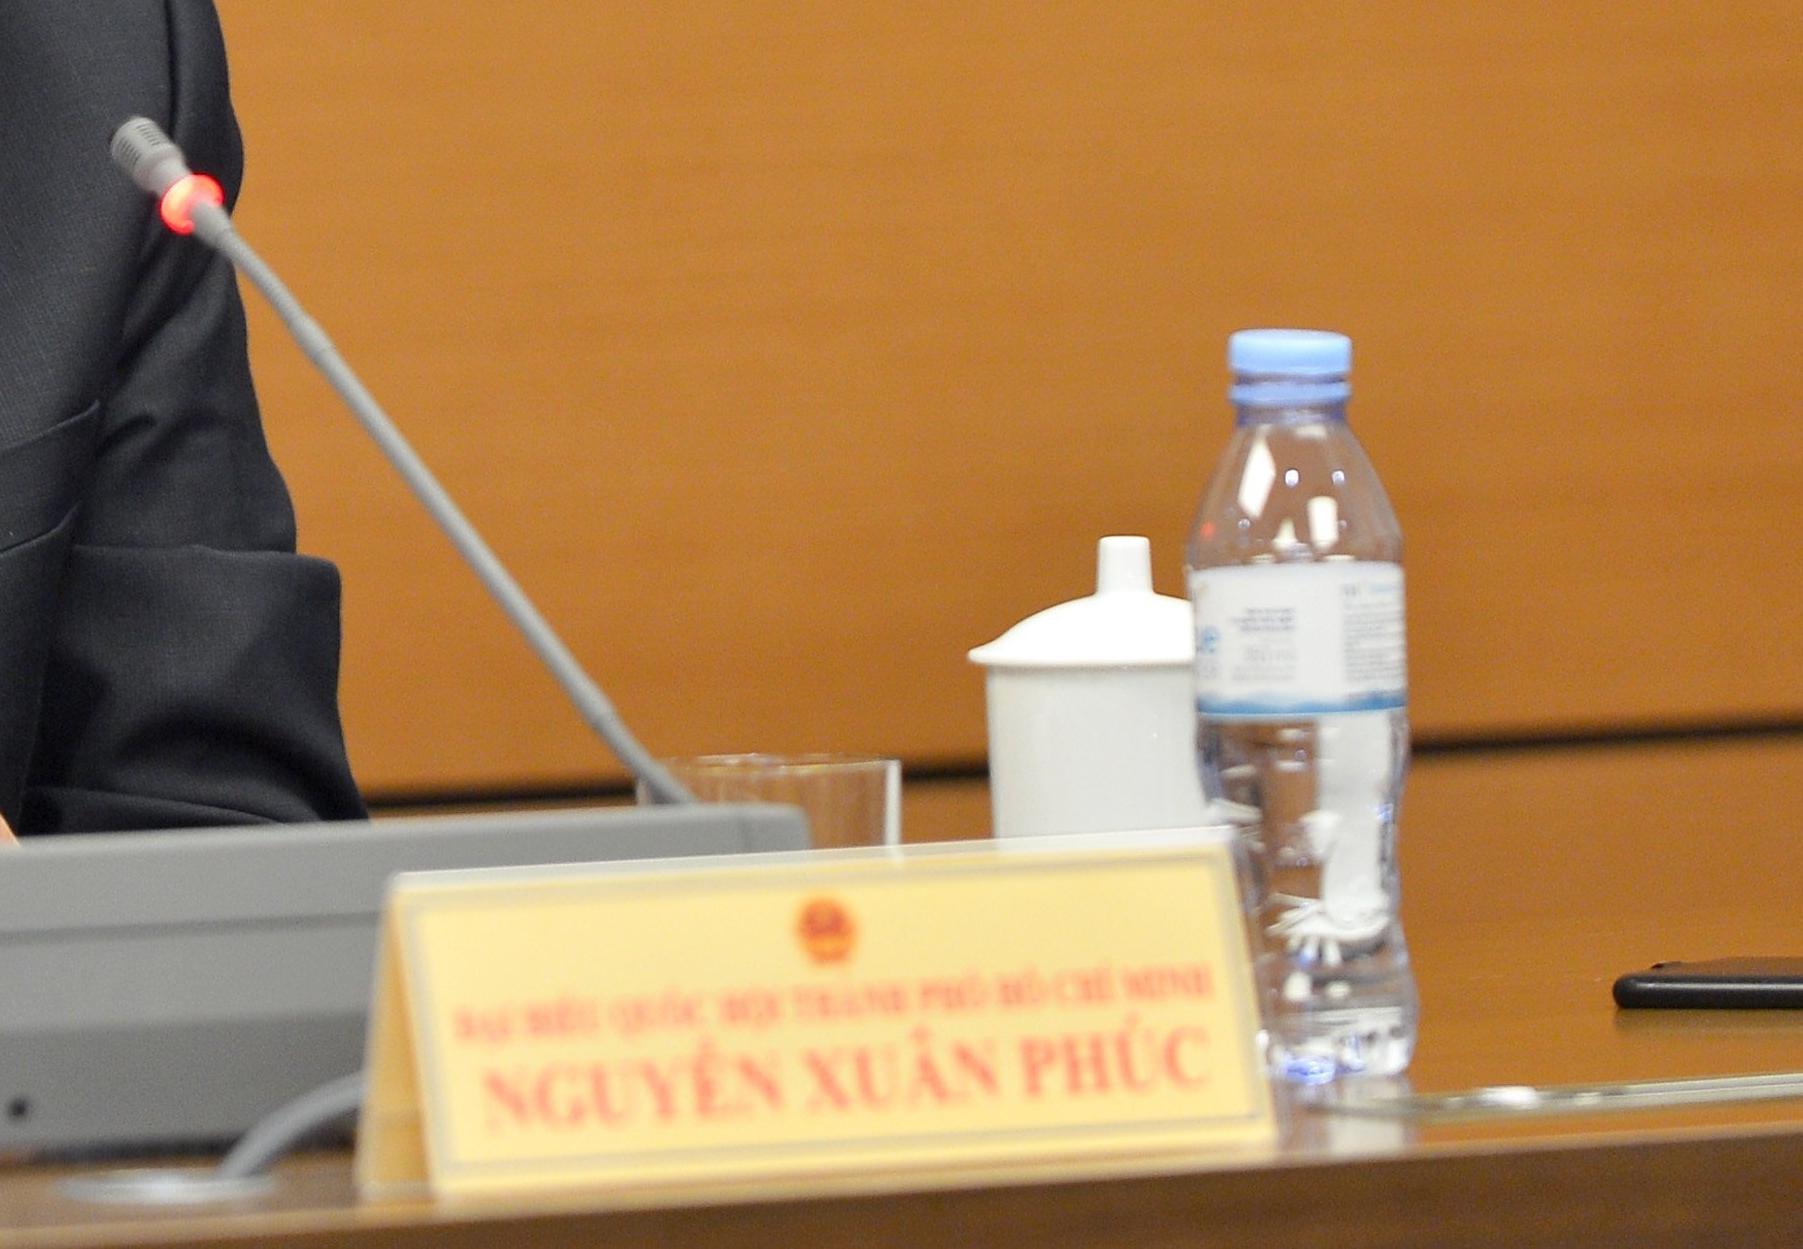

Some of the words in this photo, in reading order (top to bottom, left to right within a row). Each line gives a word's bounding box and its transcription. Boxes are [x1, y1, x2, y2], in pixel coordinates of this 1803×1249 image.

[920, 969, 989, 1015] PHỐ
[1053, 961, 1115, 1005] CHÍ
[1121, 961, 1214, 1002] MINH
[483, 1036, 783, 1132] NGUYỄN
[803, 1024, 1000, 1111] XUÂN
[1020, 1011, 1212, 1097] PHÚC
